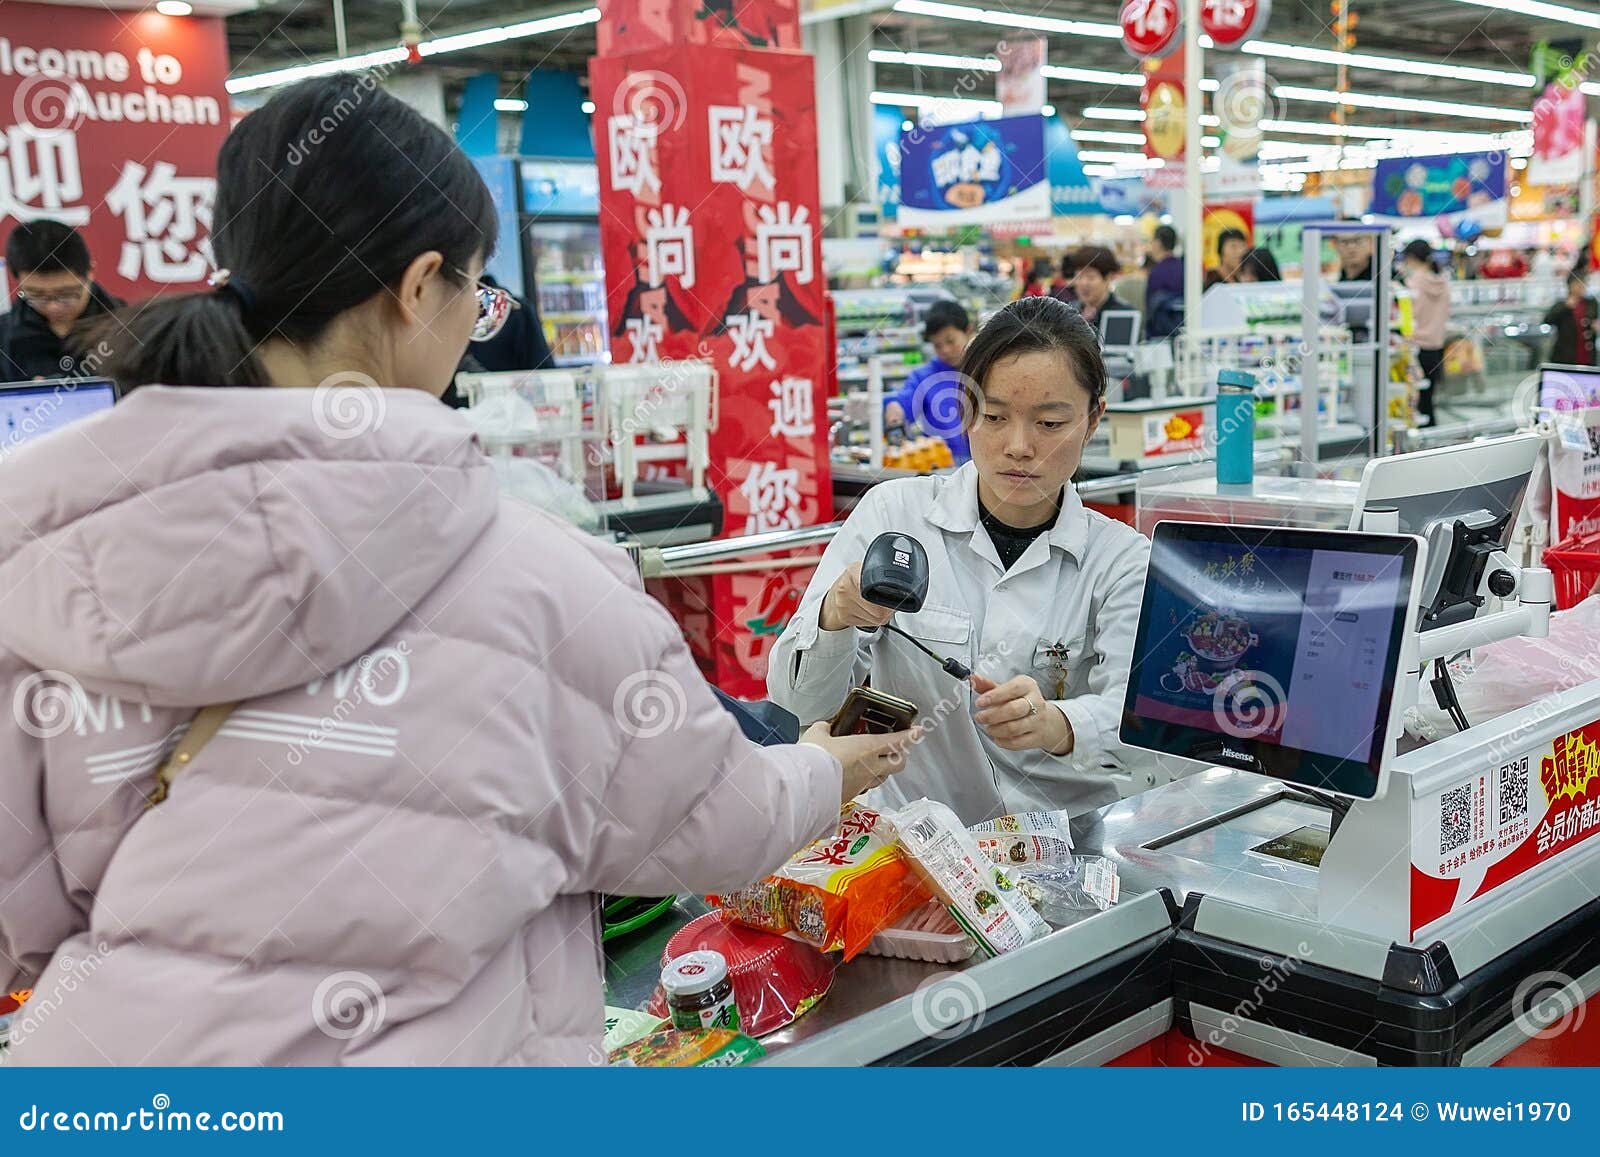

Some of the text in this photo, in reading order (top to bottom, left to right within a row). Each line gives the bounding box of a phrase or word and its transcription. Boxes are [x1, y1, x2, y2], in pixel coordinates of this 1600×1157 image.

[1130, 0, 1168, 38] 14
[138, 47, 182, 85] to
[65, 83, 220, 125] Auchan
[1222, 747, 1255, 763] Hisense
[1439, 852, 1467, 875] 电子会员
